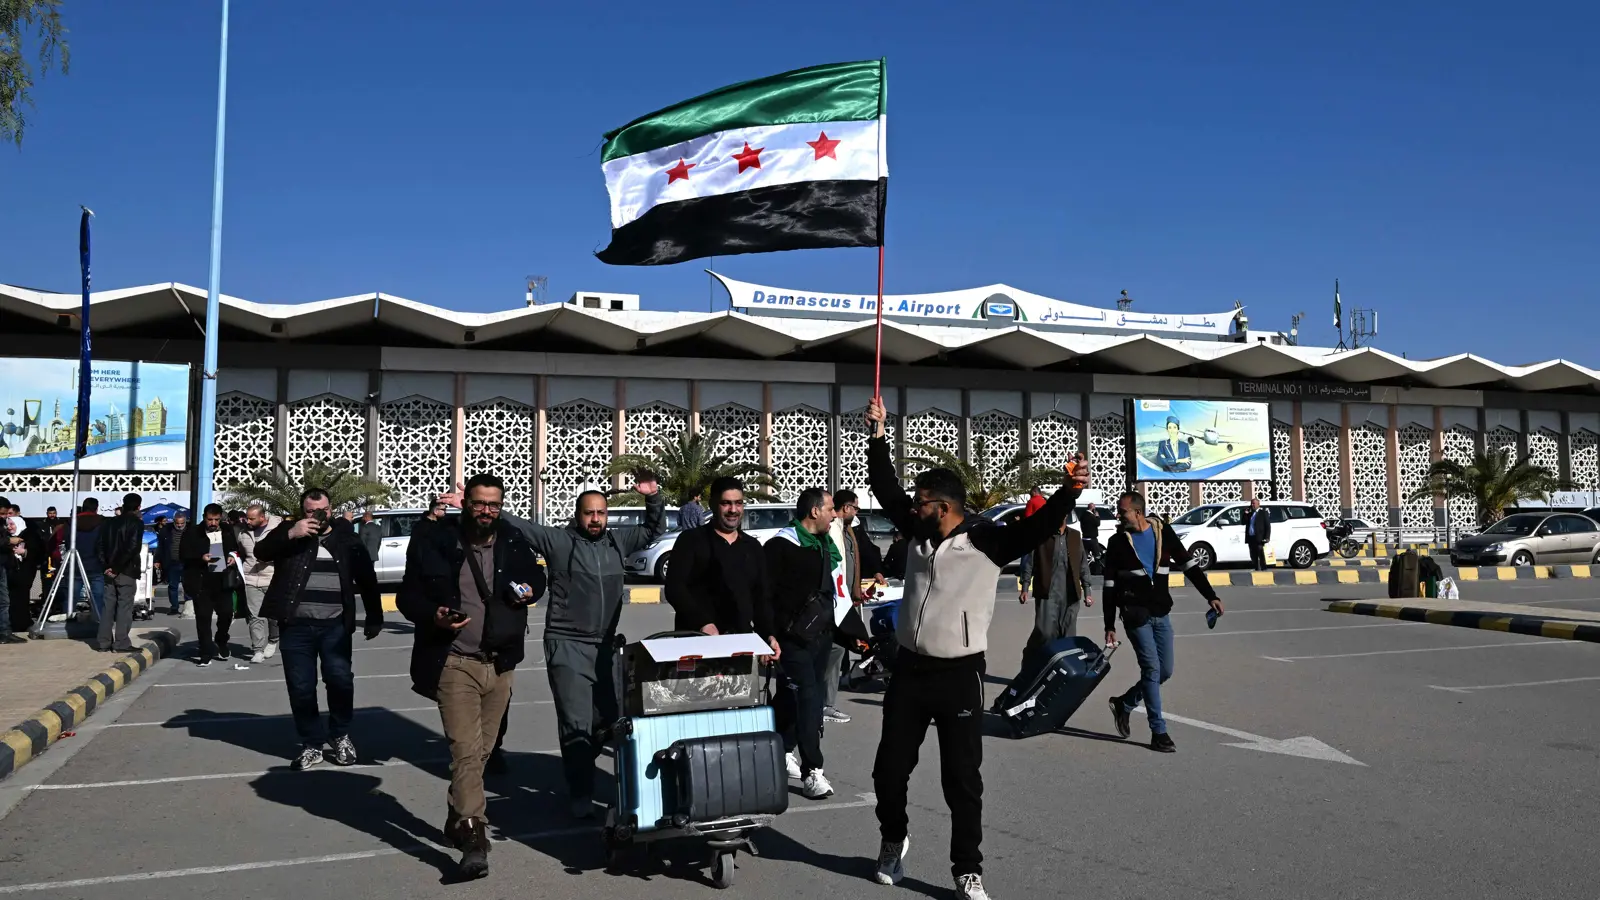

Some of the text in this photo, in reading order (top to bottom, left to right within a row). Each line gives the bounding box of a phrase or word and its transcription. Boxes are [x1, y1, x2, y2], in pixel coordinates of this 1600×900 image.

[752, 291, 851, 309] Damascus
[899, 299, 961, 317] Airport
[1238, 382, 1302, 394] TERMINAL NO.1
